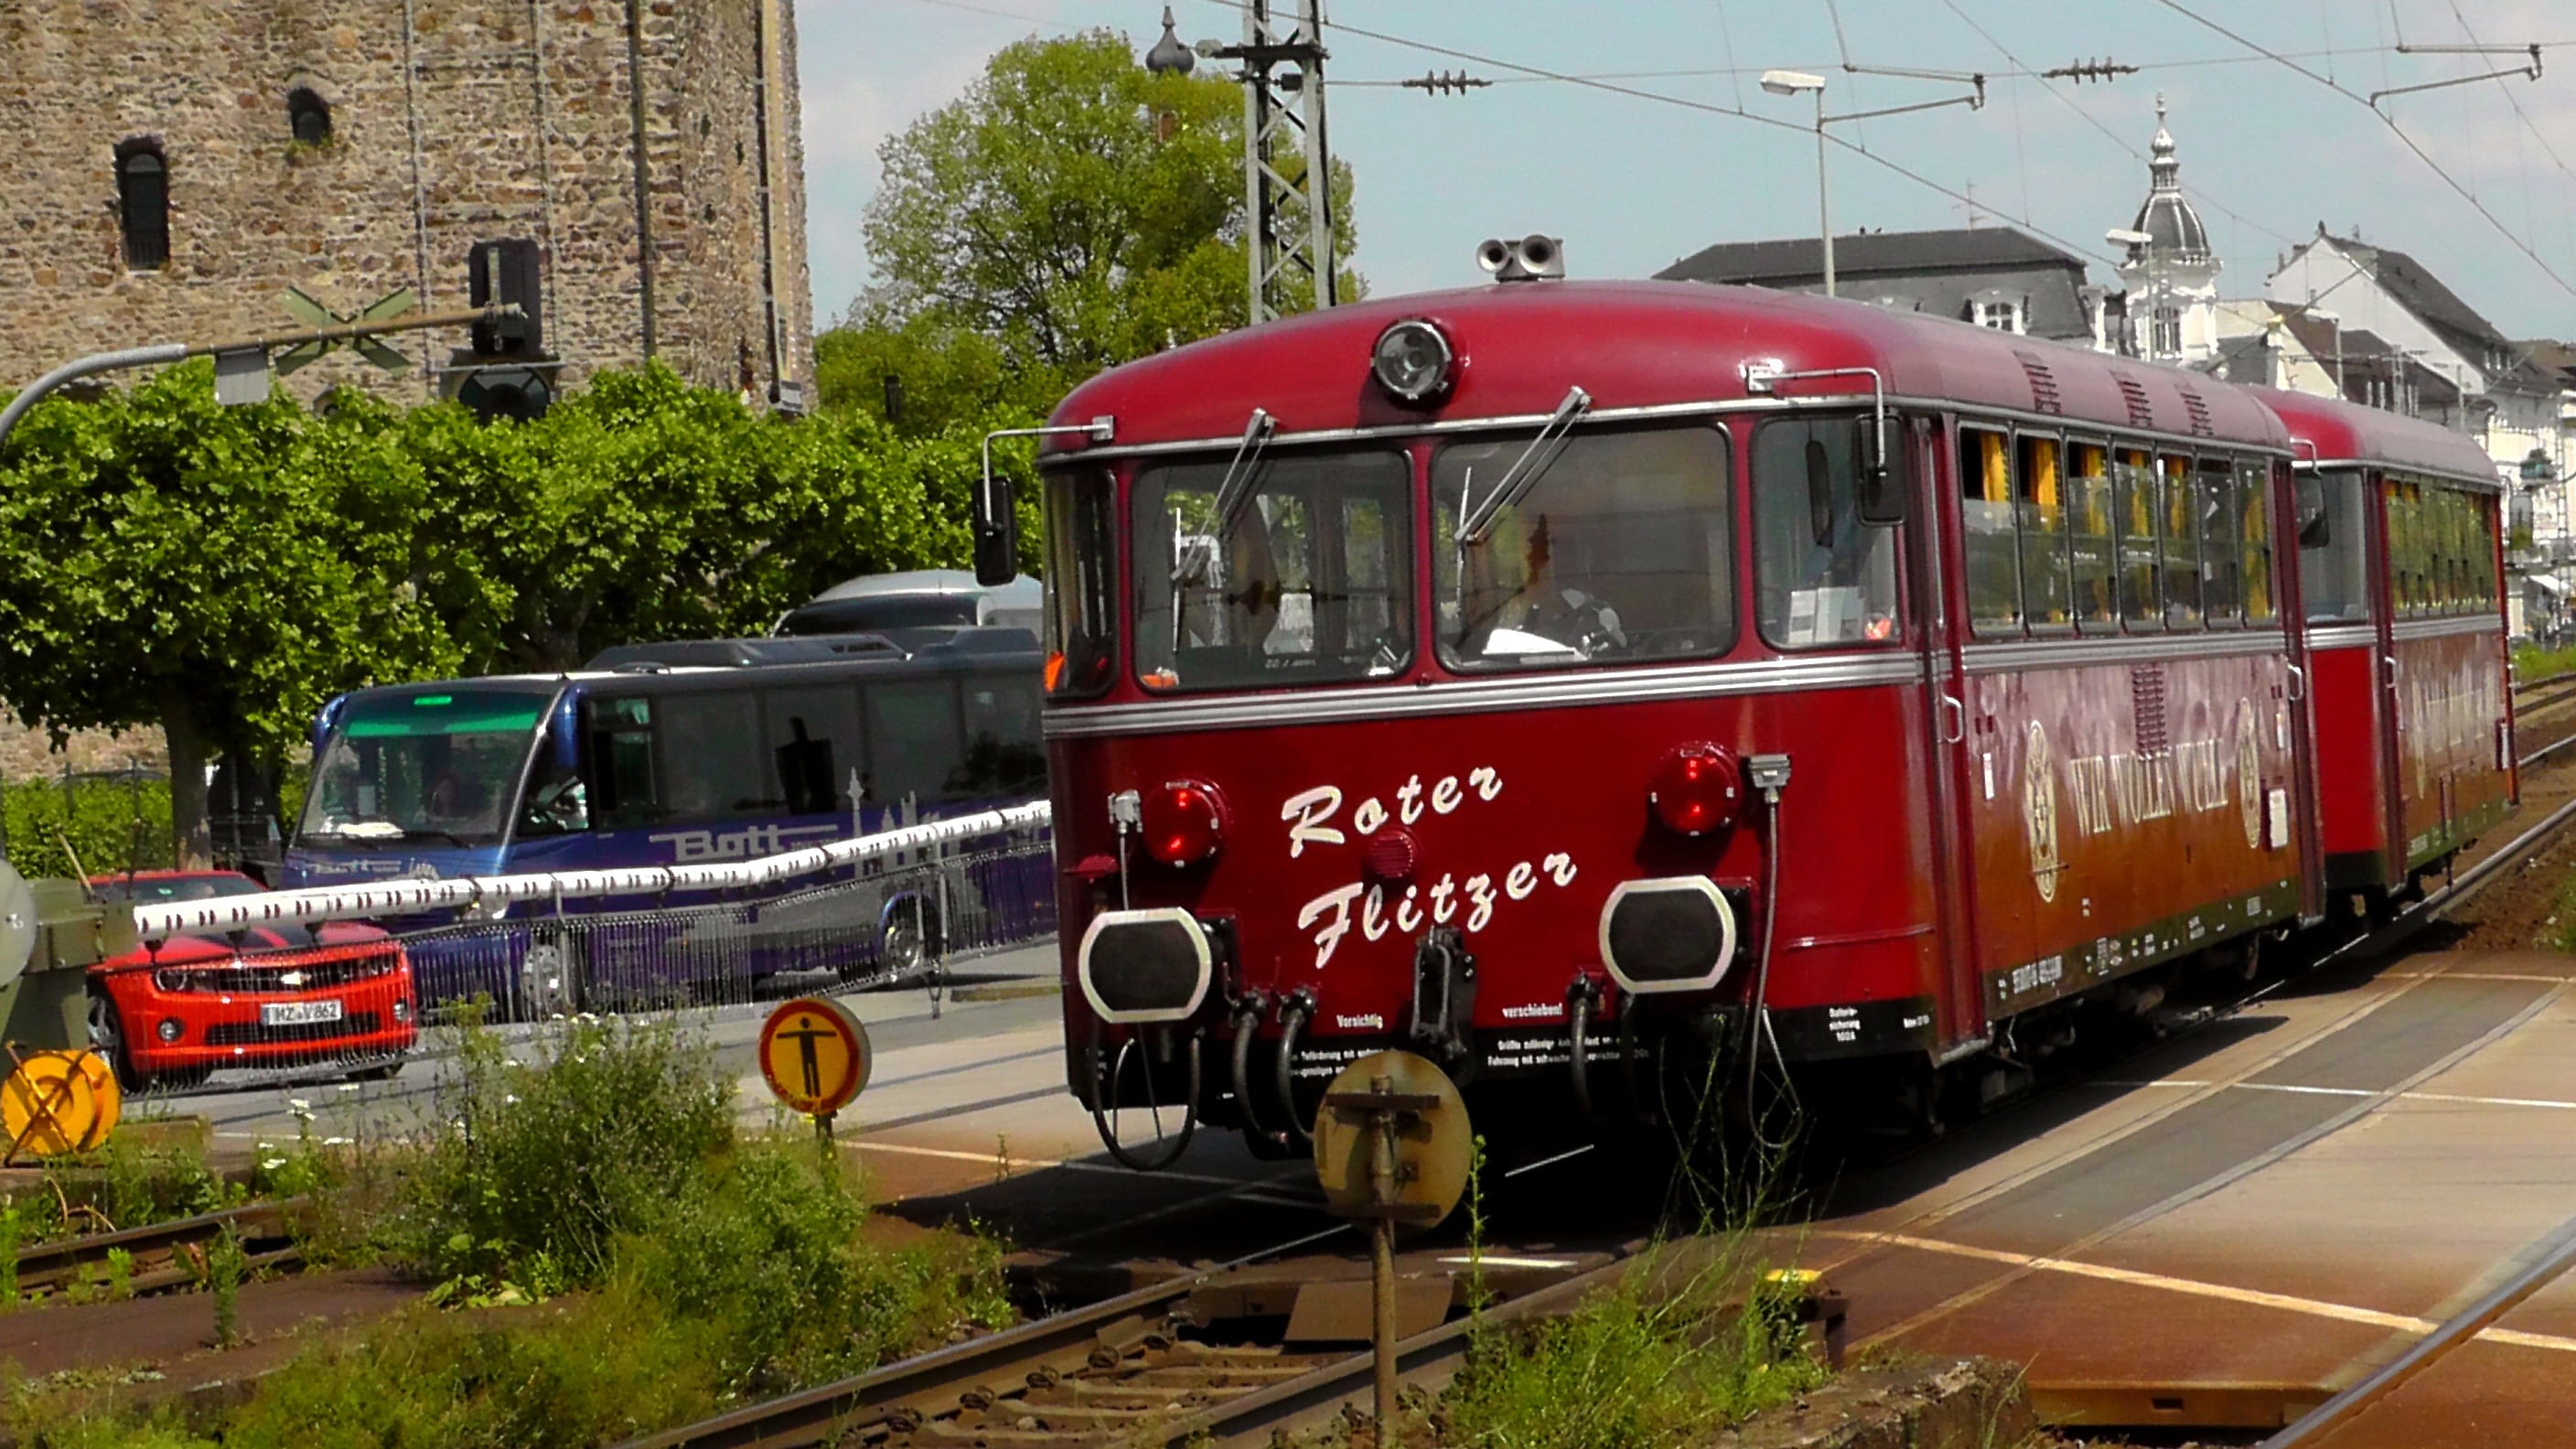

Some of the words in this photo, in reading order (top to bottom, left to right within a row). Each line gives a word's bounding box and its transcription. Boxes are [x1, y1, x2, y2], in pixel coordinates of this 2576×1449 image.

[1281, 766, 1504, 859] Roter
[1297, 851, 1578, 970] Flitzer
[1336, 1013, 1384, 1030] Vorsichtig
